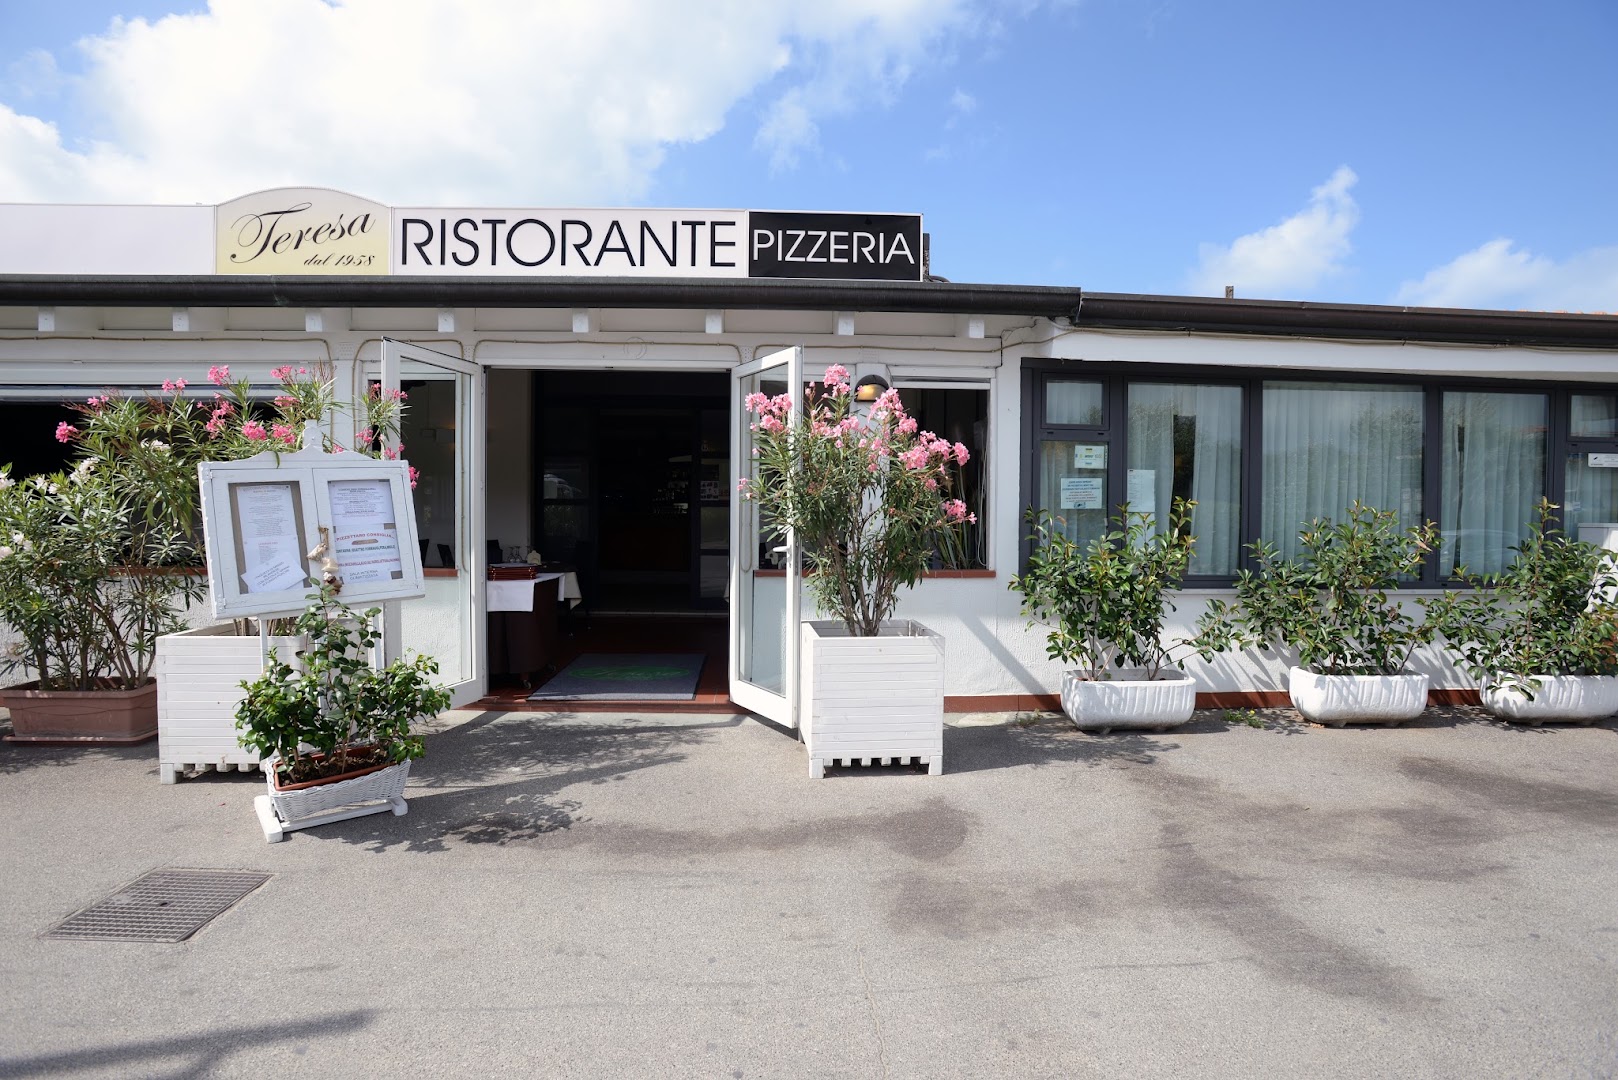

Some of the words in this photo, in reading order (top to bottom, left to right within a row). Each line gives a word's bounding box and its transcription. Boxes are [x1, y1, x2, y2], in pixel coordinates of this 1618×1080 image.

[230, 202, 376, 263] Teresa
[401, 218, 736, 267] RISTORANTE
[753, 229, 915, 264] PIZZERIA
[303, 253, 334, 266] dal
[334, 254, 375, 267] 1958
